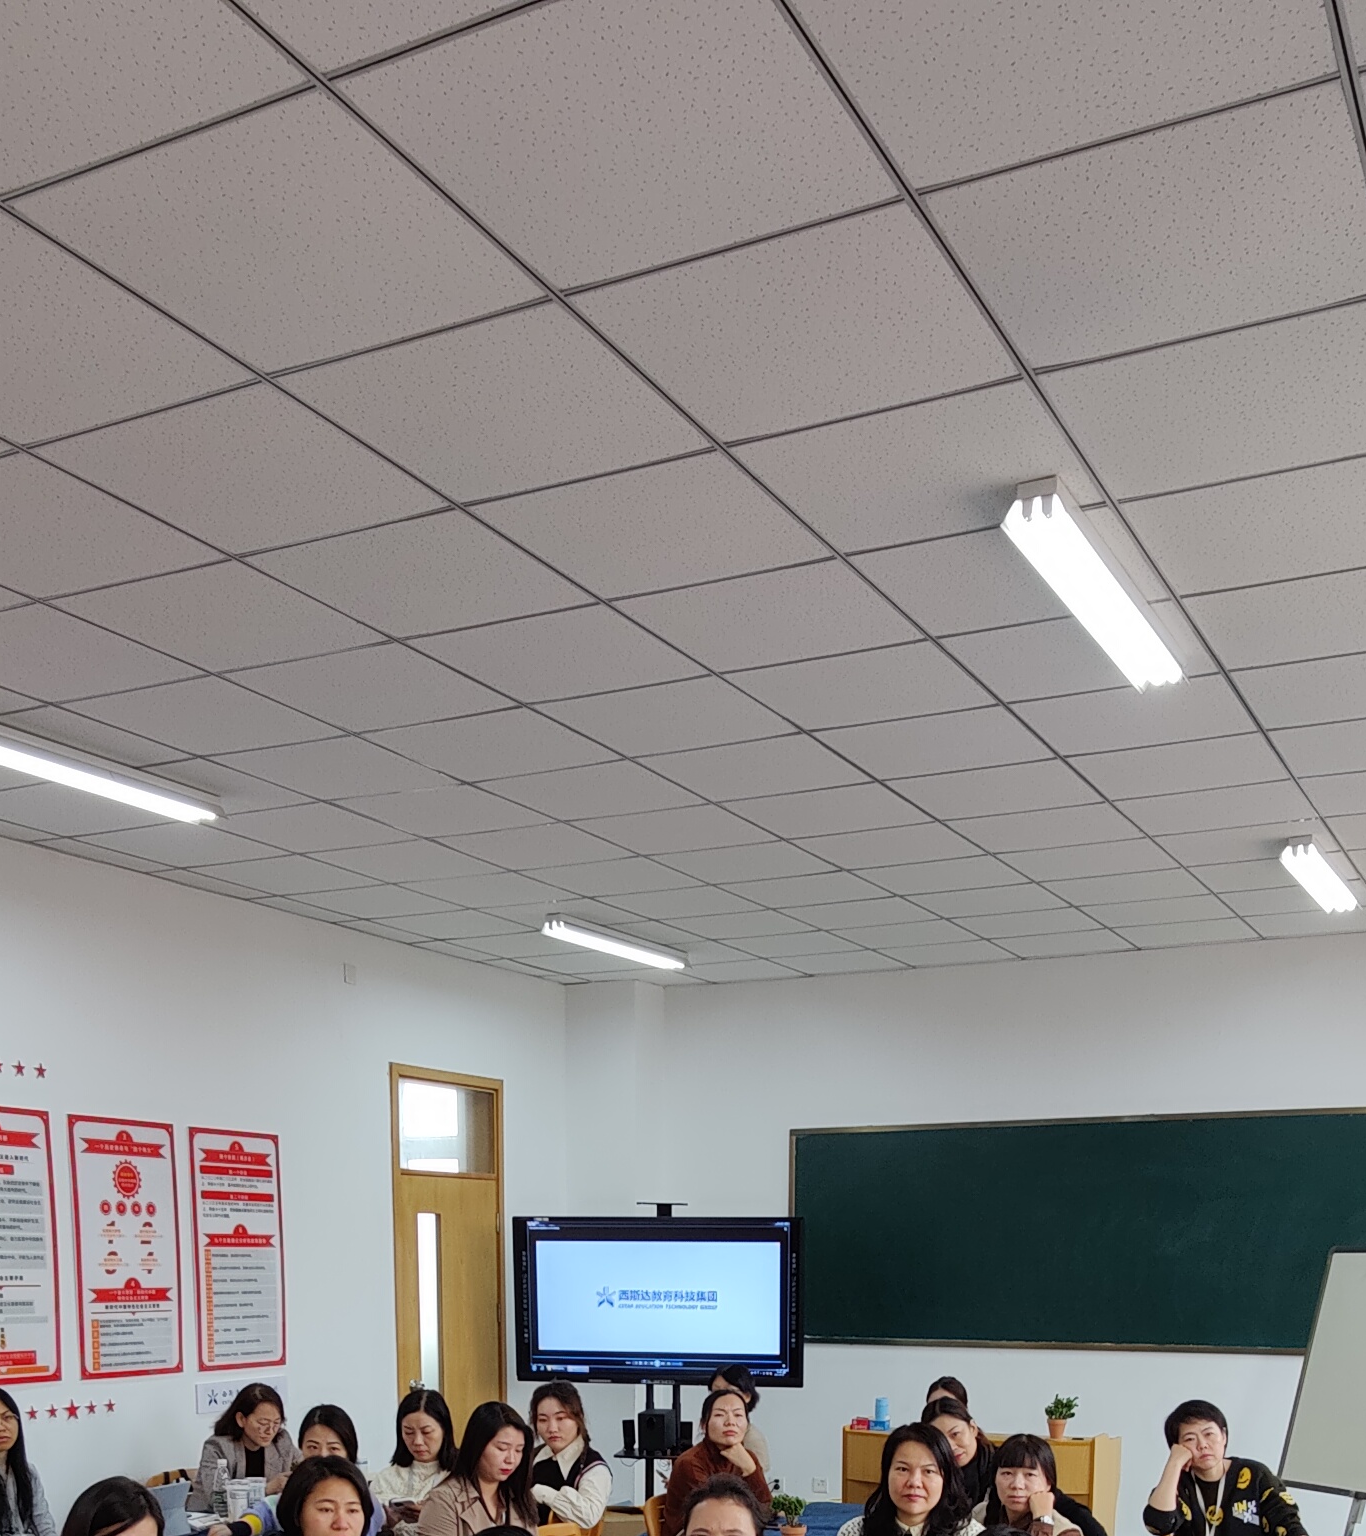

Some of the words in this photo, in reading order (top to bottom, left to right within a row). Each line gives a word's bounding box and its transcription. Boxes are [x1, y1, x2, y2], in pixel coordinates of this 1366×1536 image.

[619, 1290, 717, 1302] 西斯达教育科技集团
